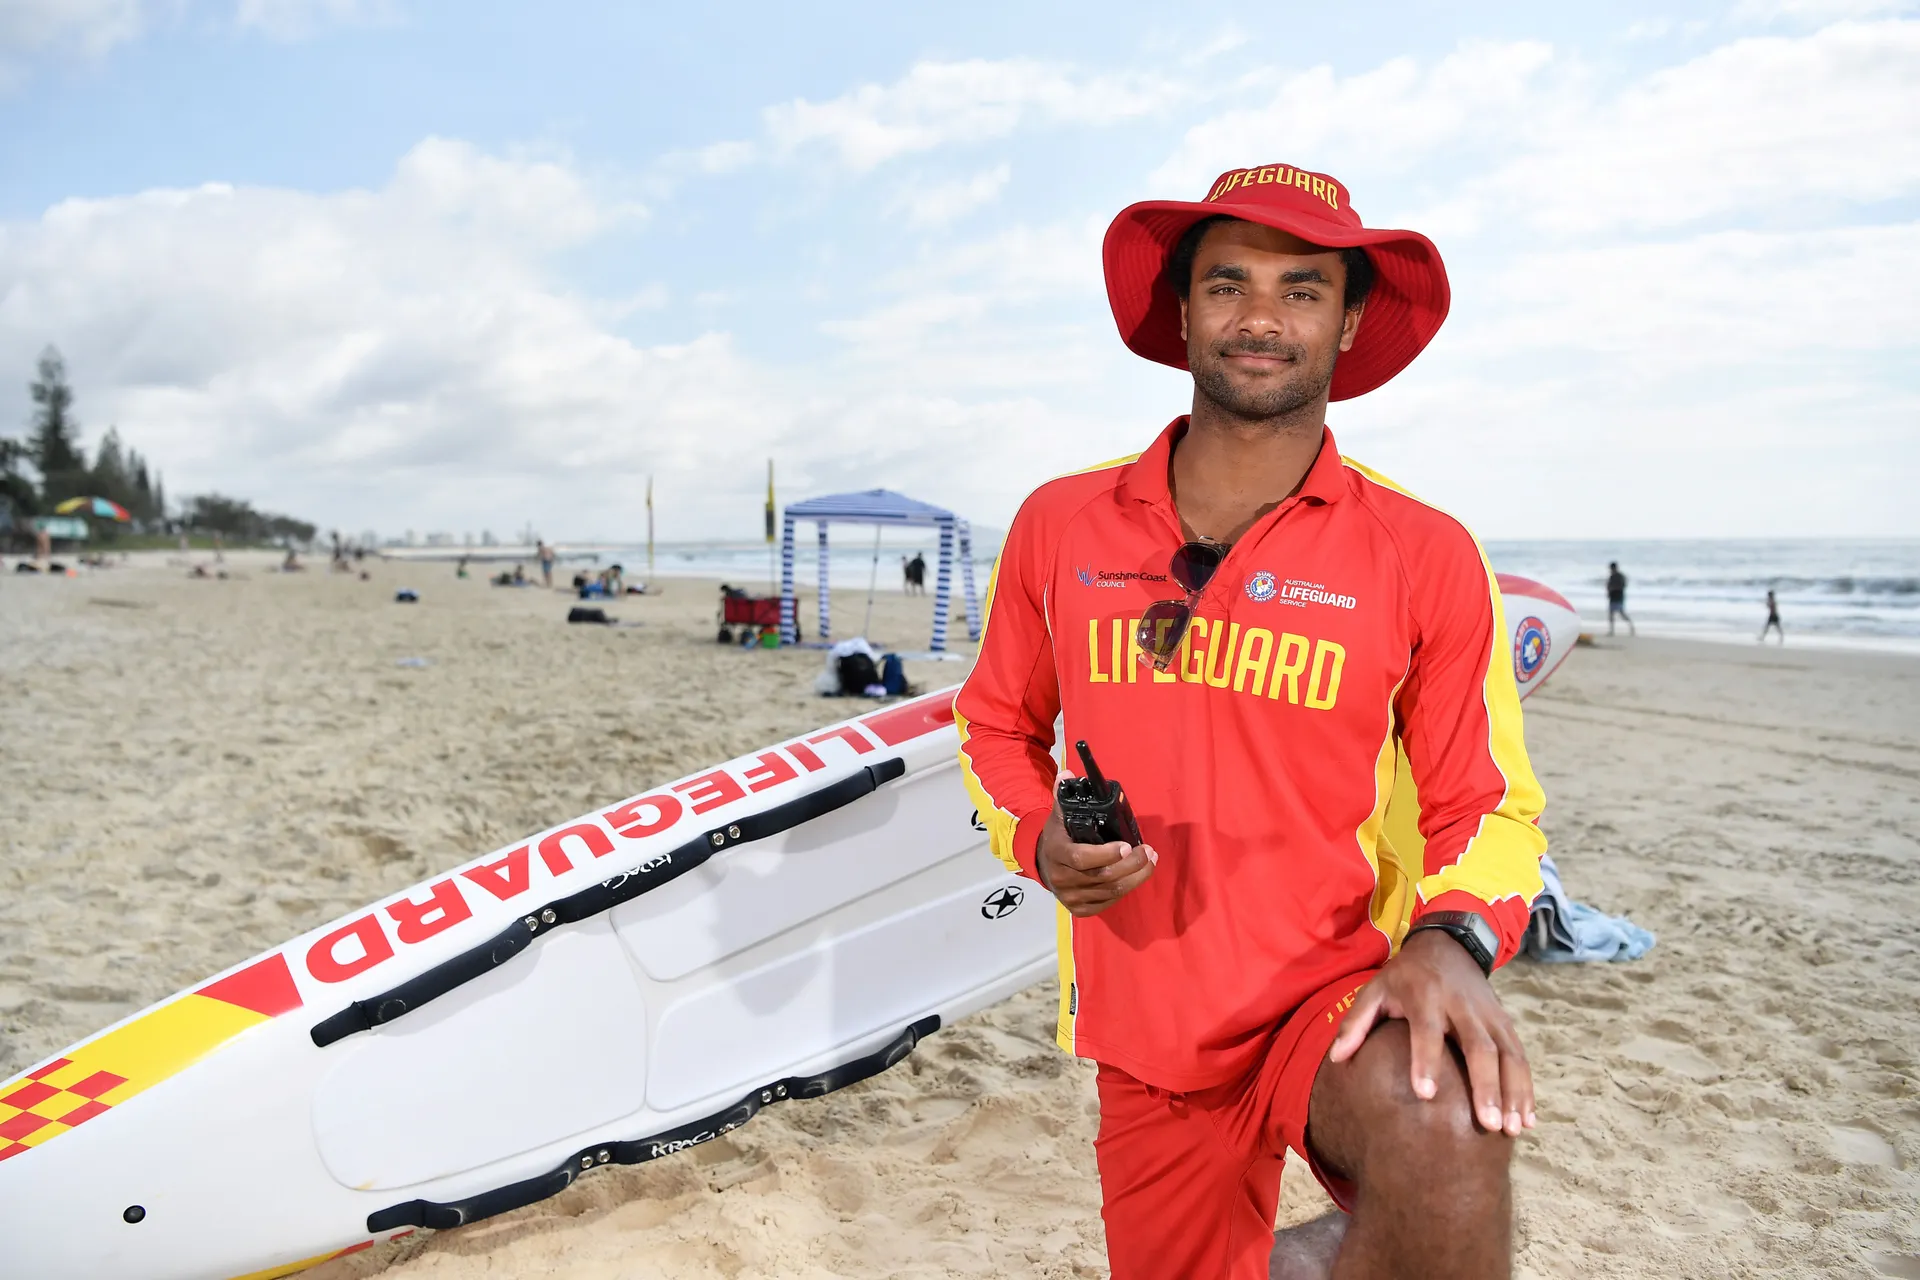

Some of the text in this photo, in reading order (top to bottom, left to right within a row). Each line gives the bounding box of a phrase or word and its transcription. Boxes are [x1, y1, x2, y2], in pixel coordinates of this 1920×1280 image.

[1210, 167, 1338, 210] LIFEGUARD
[1096, 580, 1126, 588] COUNCIL
[1098, 570, 1168, 582] Sunshine Coast
[1284, 578, 1325, 590] AUSTRALIAN
[1279, 598, 1307, 608] SERVICE
[1281, 585, 1356, 610] LIFEGUARD
[1088, 617, 1346, 711] LIFEGUARD
[306, 724, 876, 983] LIFEGUARD
